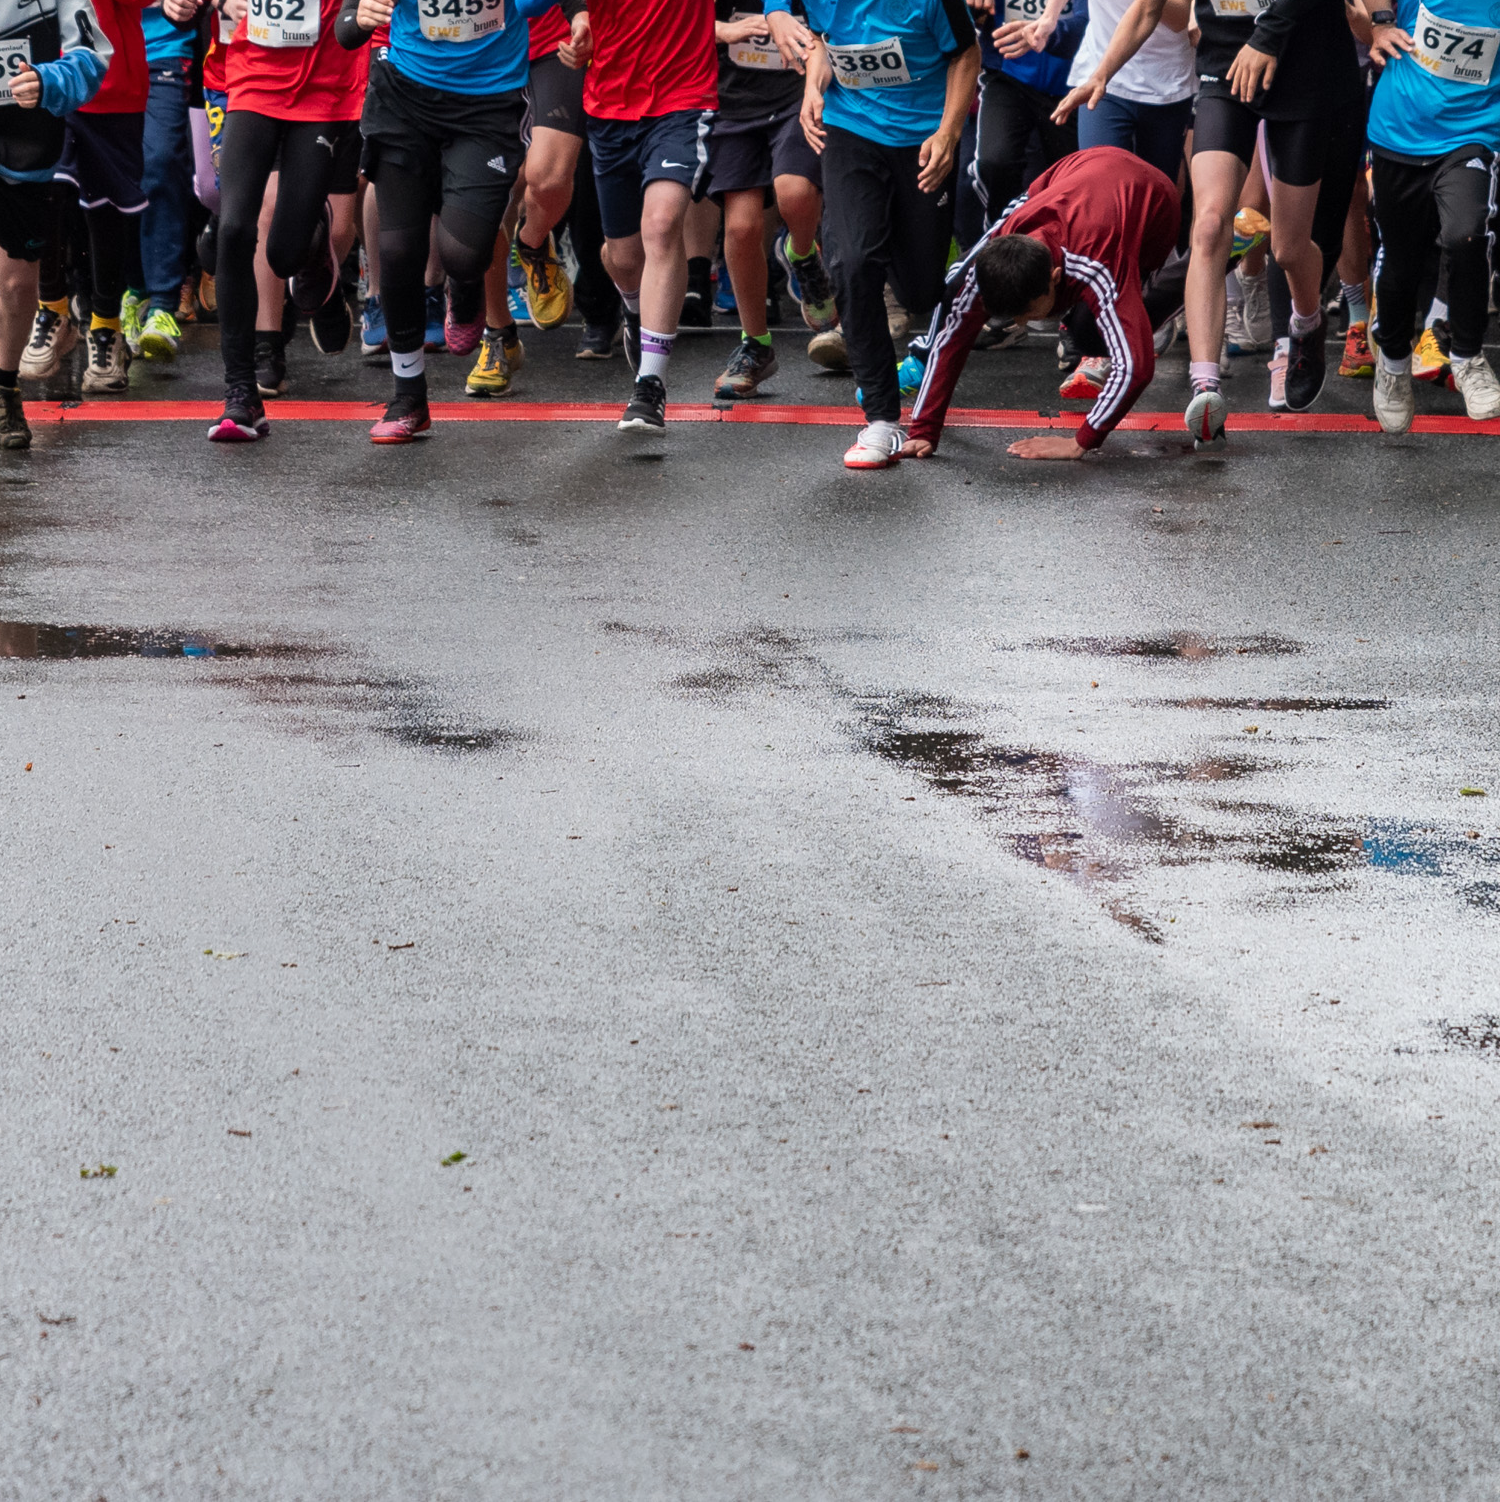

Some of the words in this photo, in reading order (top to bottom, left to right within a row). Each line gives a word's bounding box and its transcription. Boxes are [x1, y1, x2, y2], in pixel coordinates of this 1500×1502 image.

[1219, 0, 1247, 11] EWE
[447, 17, 474, 26] Simon
[473, 18, 499, 33] bruns
[282, 29, 311, 41] bruns
[428, 25, 461, 37] EWE
[1423, 26, 1485, 60] 674
[736, 50, 768, 65] EWE
[827, 50, 902, 72] 3380
[1412, 48, 1442, 72] EWE
[1453, 65, 1483, 79] bruns
[838, 75, 860, 86] WE
[872, 74, 902, 85] bruns
